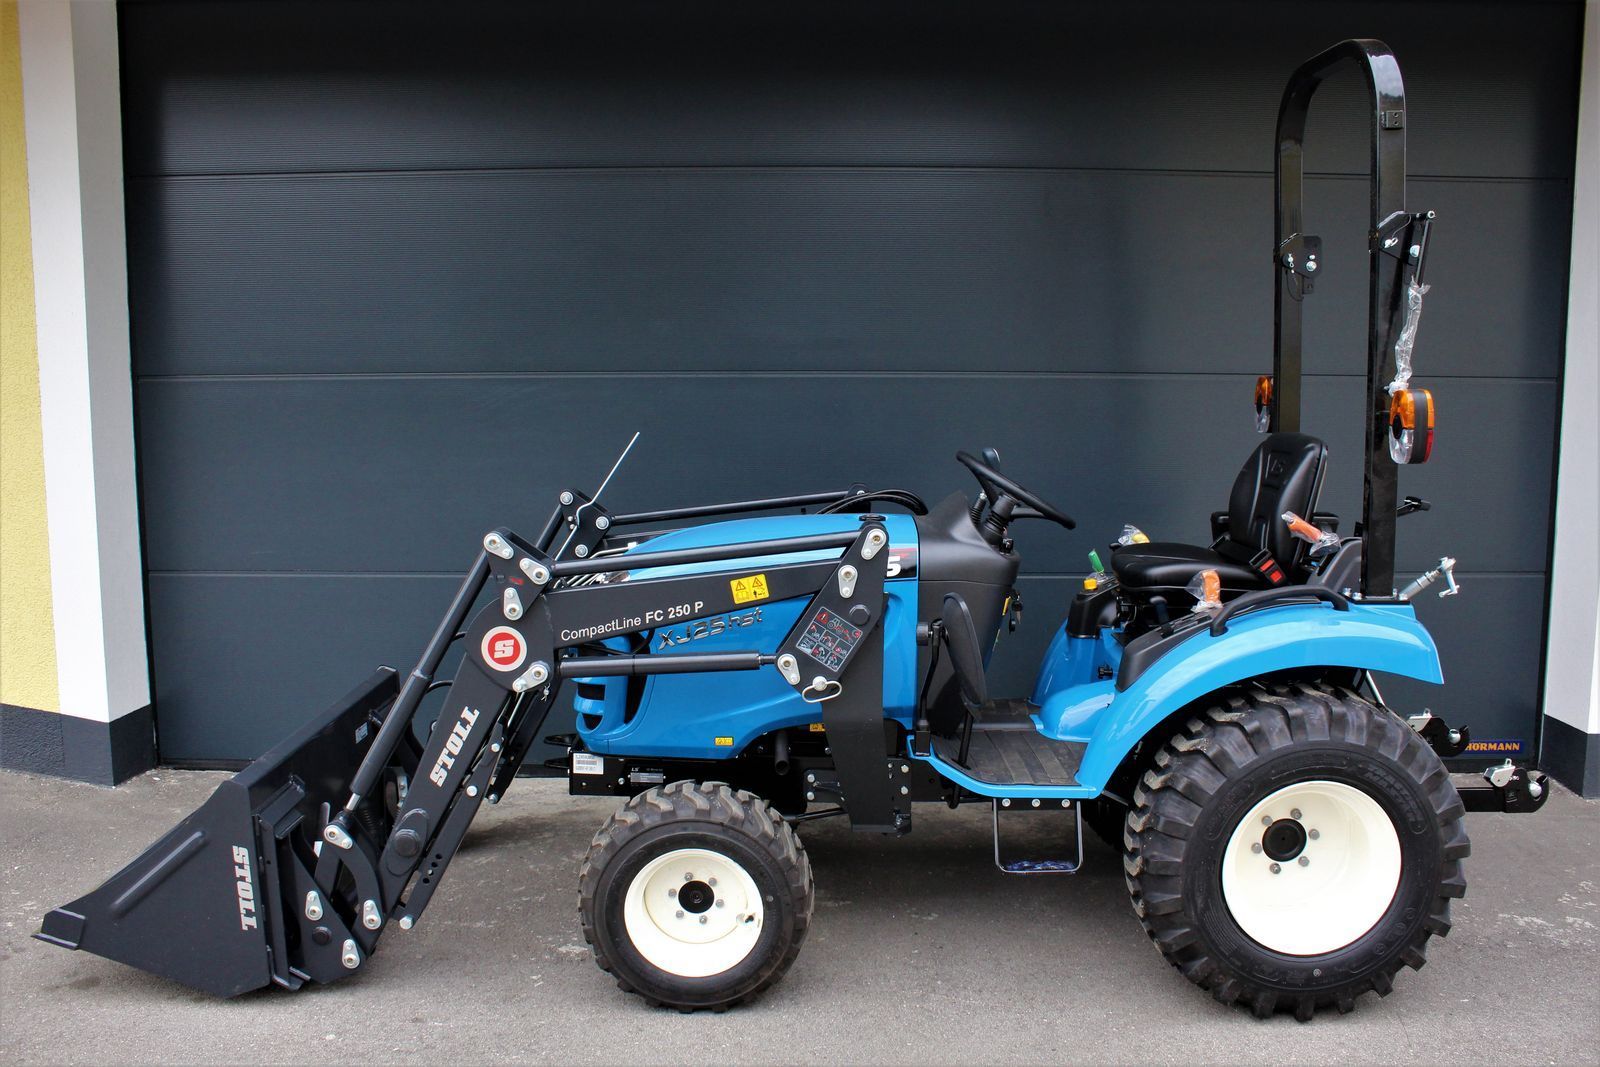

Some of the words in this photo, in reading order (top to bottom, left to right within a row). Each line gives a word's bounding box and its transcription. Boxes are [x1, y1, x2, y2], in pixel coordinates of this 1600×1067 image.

[561, 616, 641, 642] CompactLine
[645, 610, 664, 624] FC
[668, 604, 691, 619] 250
[694, 601, 704, 613] P
[429, 706, 480, 788] STOLL
[232, 845, 258, 931] STOLL
